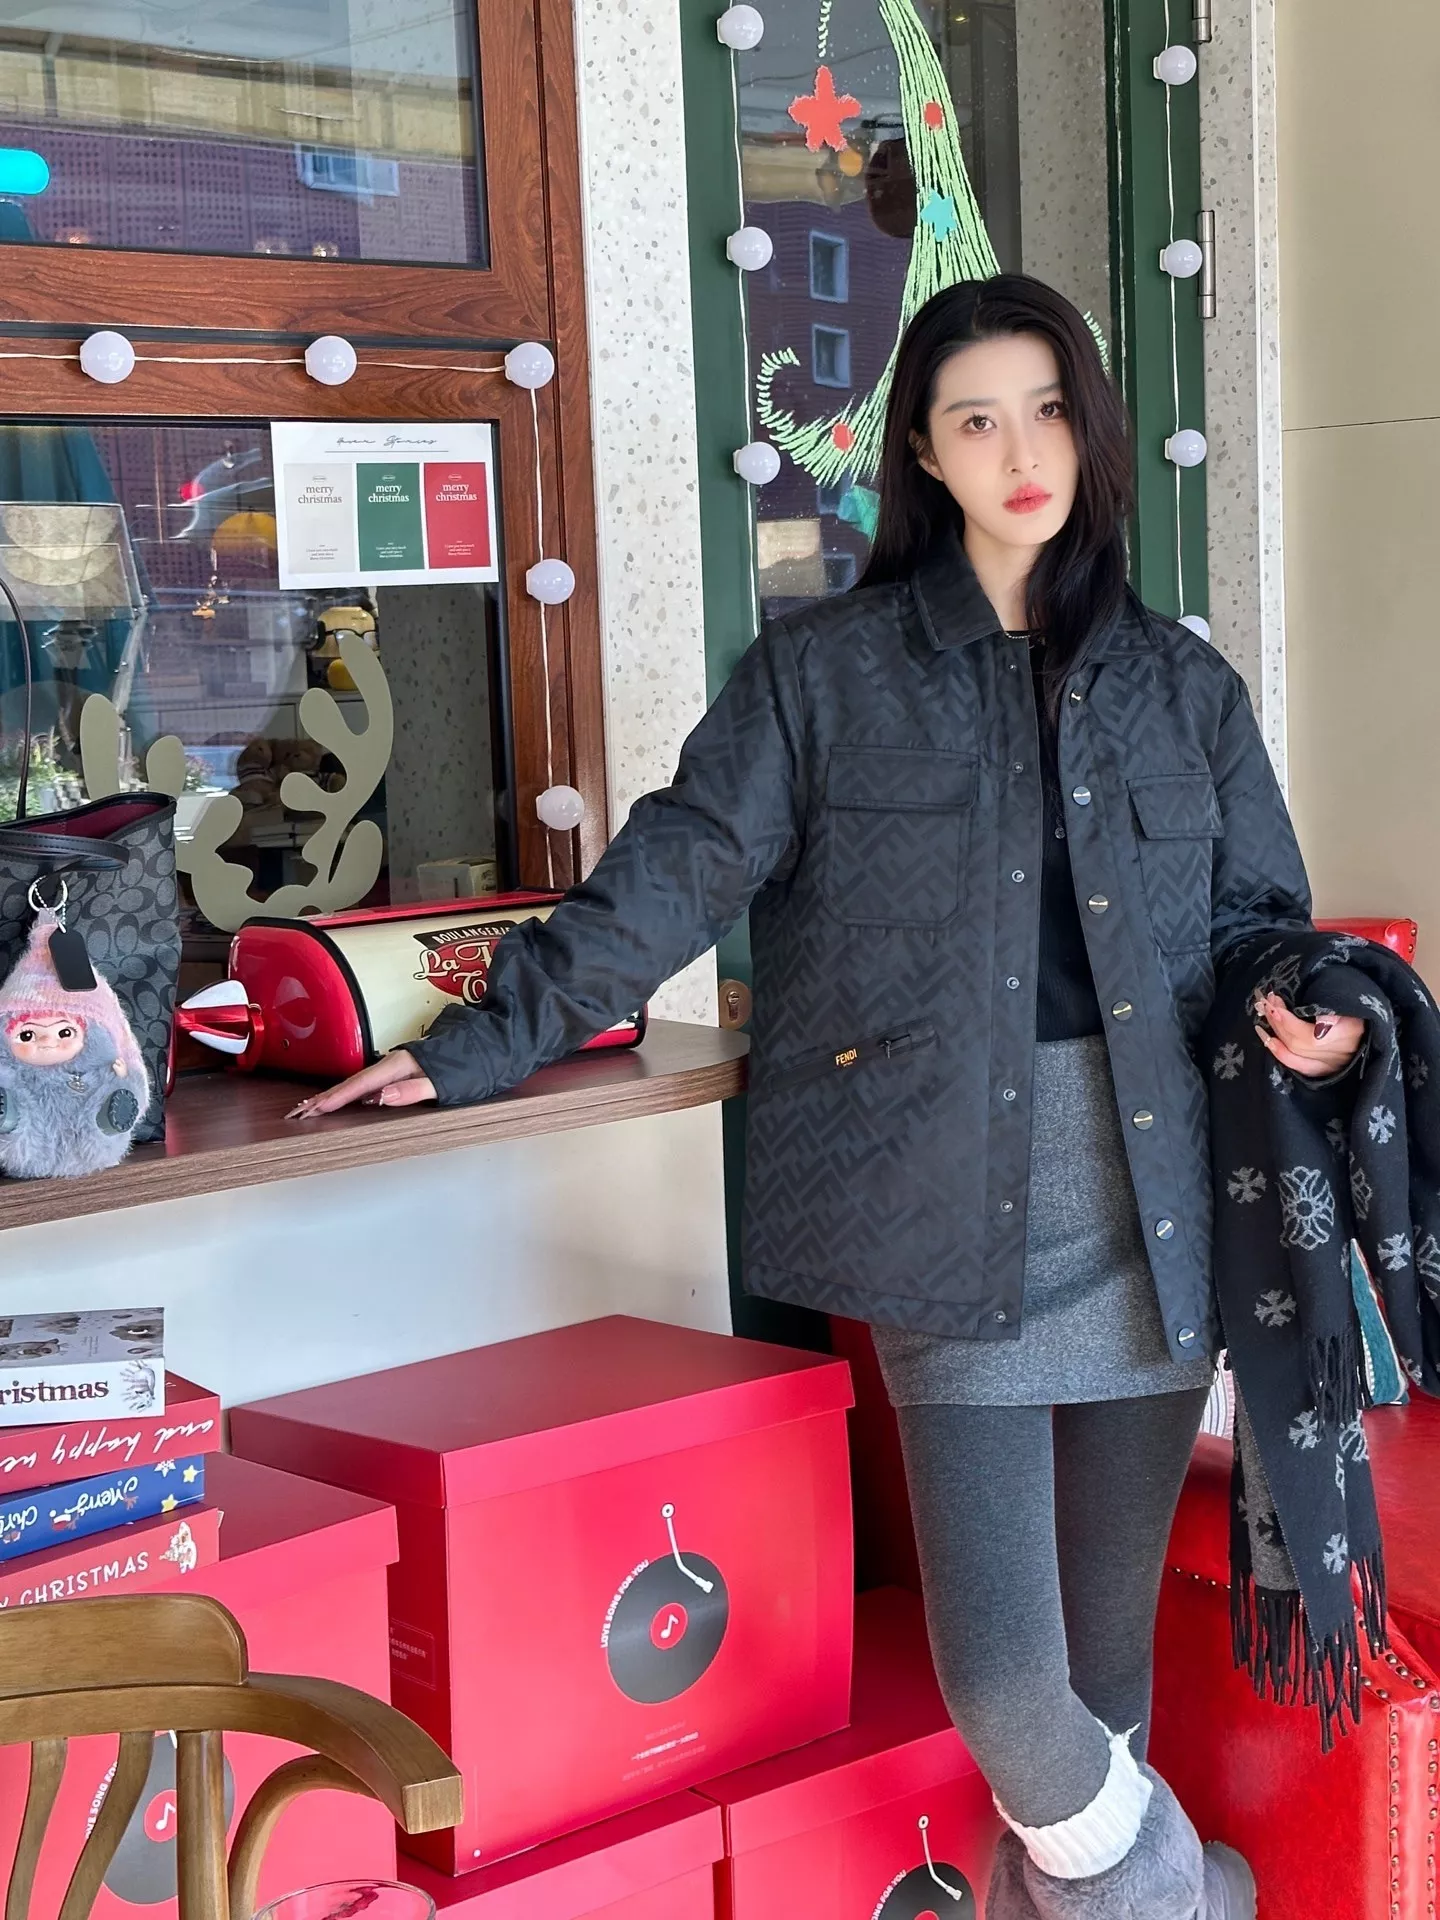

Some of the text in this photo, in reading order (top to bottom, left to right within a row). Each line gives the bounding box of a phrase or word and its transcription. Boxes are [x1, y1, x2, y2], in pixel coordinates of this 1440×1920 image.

[306, 485, 334, 495] merry
[376, 484, 402, 495] merry
[435, 492, 478, 502] christmas
[442, 483, 469, 493] merry
[298, 494, 343, 504] christmas
[368, 493, 410, 503] christmas
[835, 1048, 858, 1066] FENDI
[51, 1426, 142, 1462] happy
[153, 1419, 214, 1453] and
[20, 1551, 149, 1605] CHRISTMAS
[600, 1559, 649, 1649] LOVE SONG FOR YOU
[90, 1783, 108, 1815] SONG
[880, 1885, 893, 1904] FOR
[890, 1869, 907, 1886] YOU
